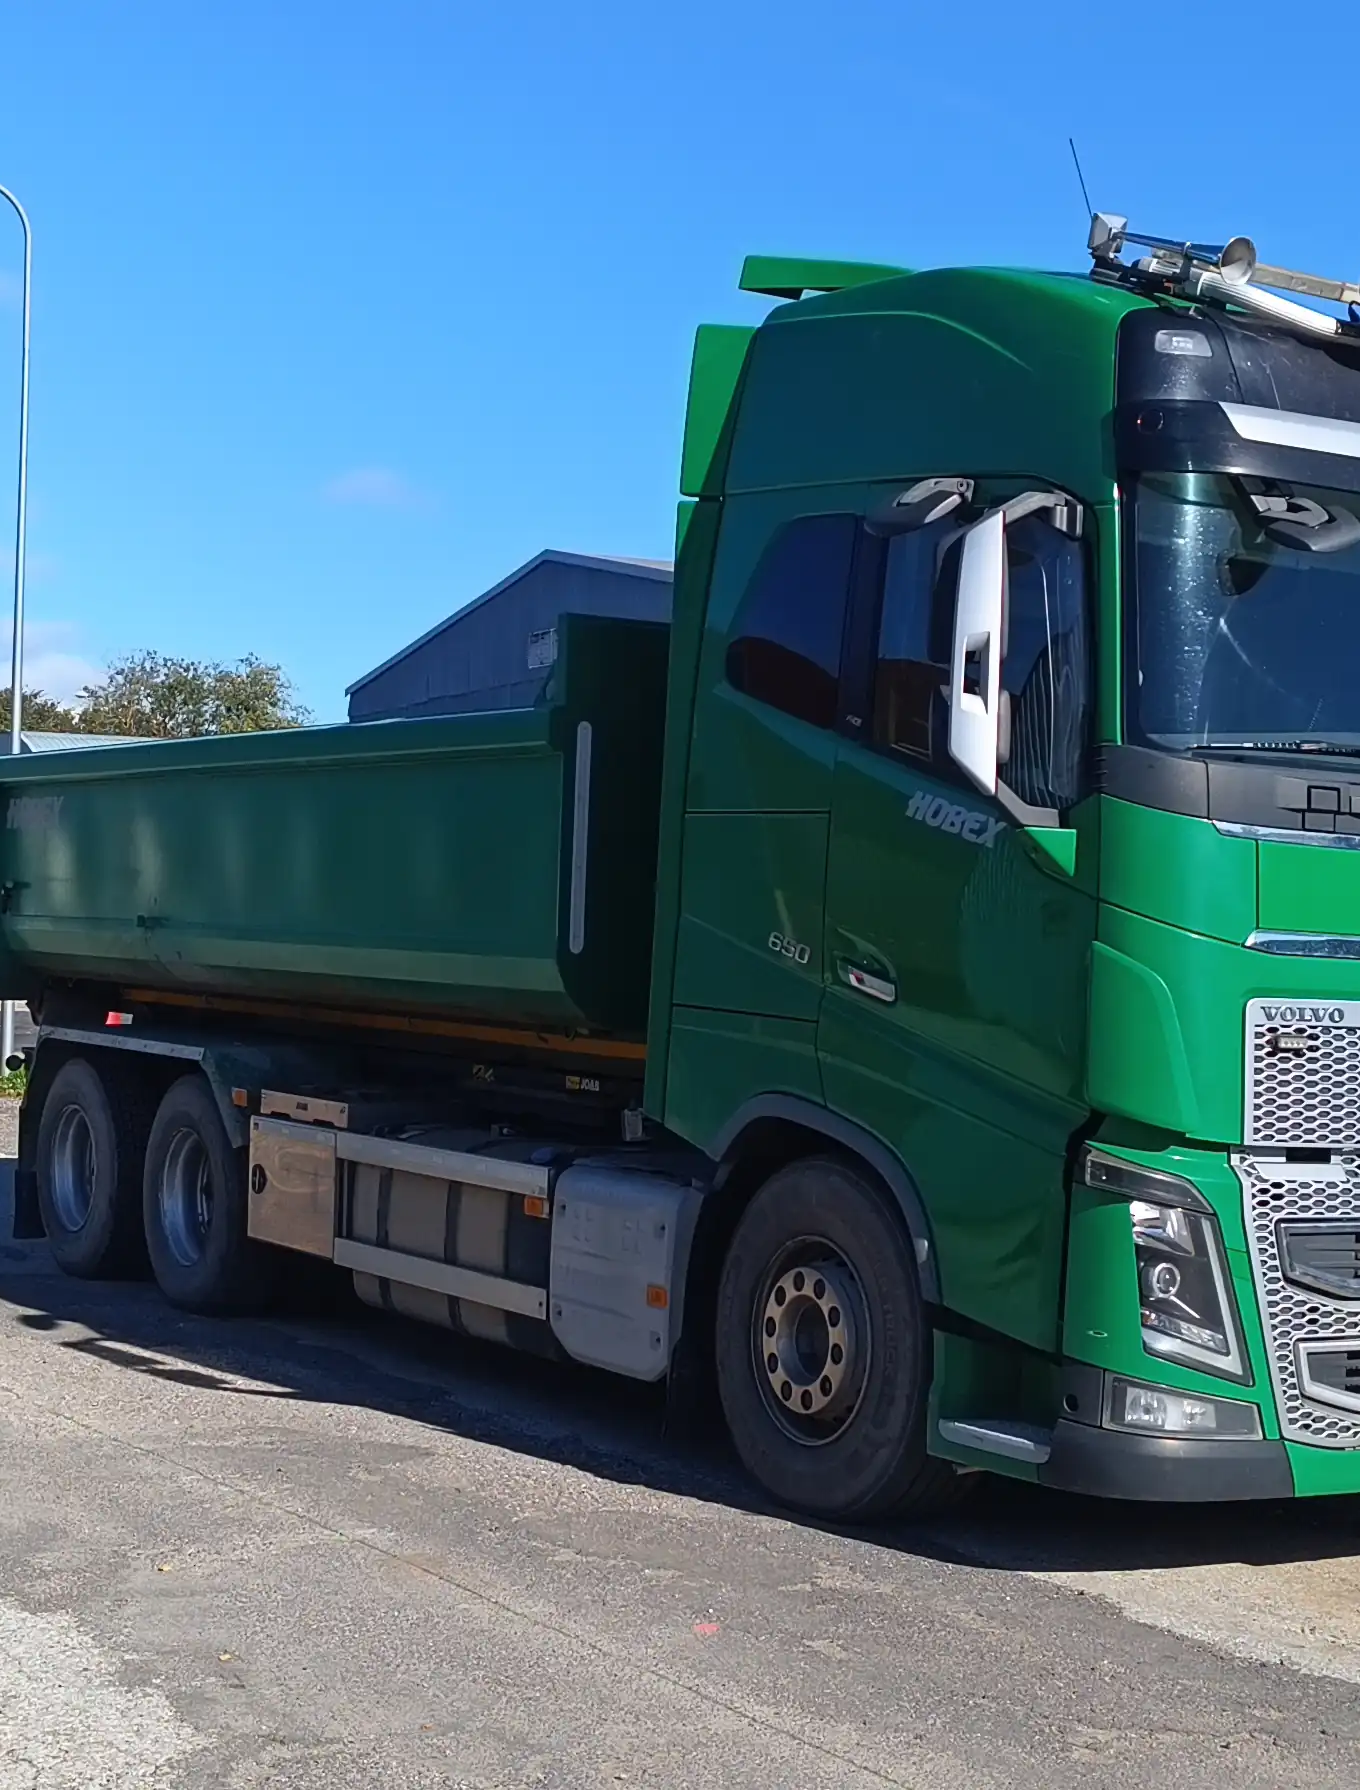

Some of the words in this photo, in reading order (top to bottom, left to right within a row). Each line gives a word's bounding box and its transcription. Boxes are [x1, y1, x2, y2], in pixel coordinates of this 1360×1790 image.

[905, 790, 1008, 848] HOBEX
[768, 931, 811, 964] 650
[1260, 1006, 1345, 1023] VOLVO
